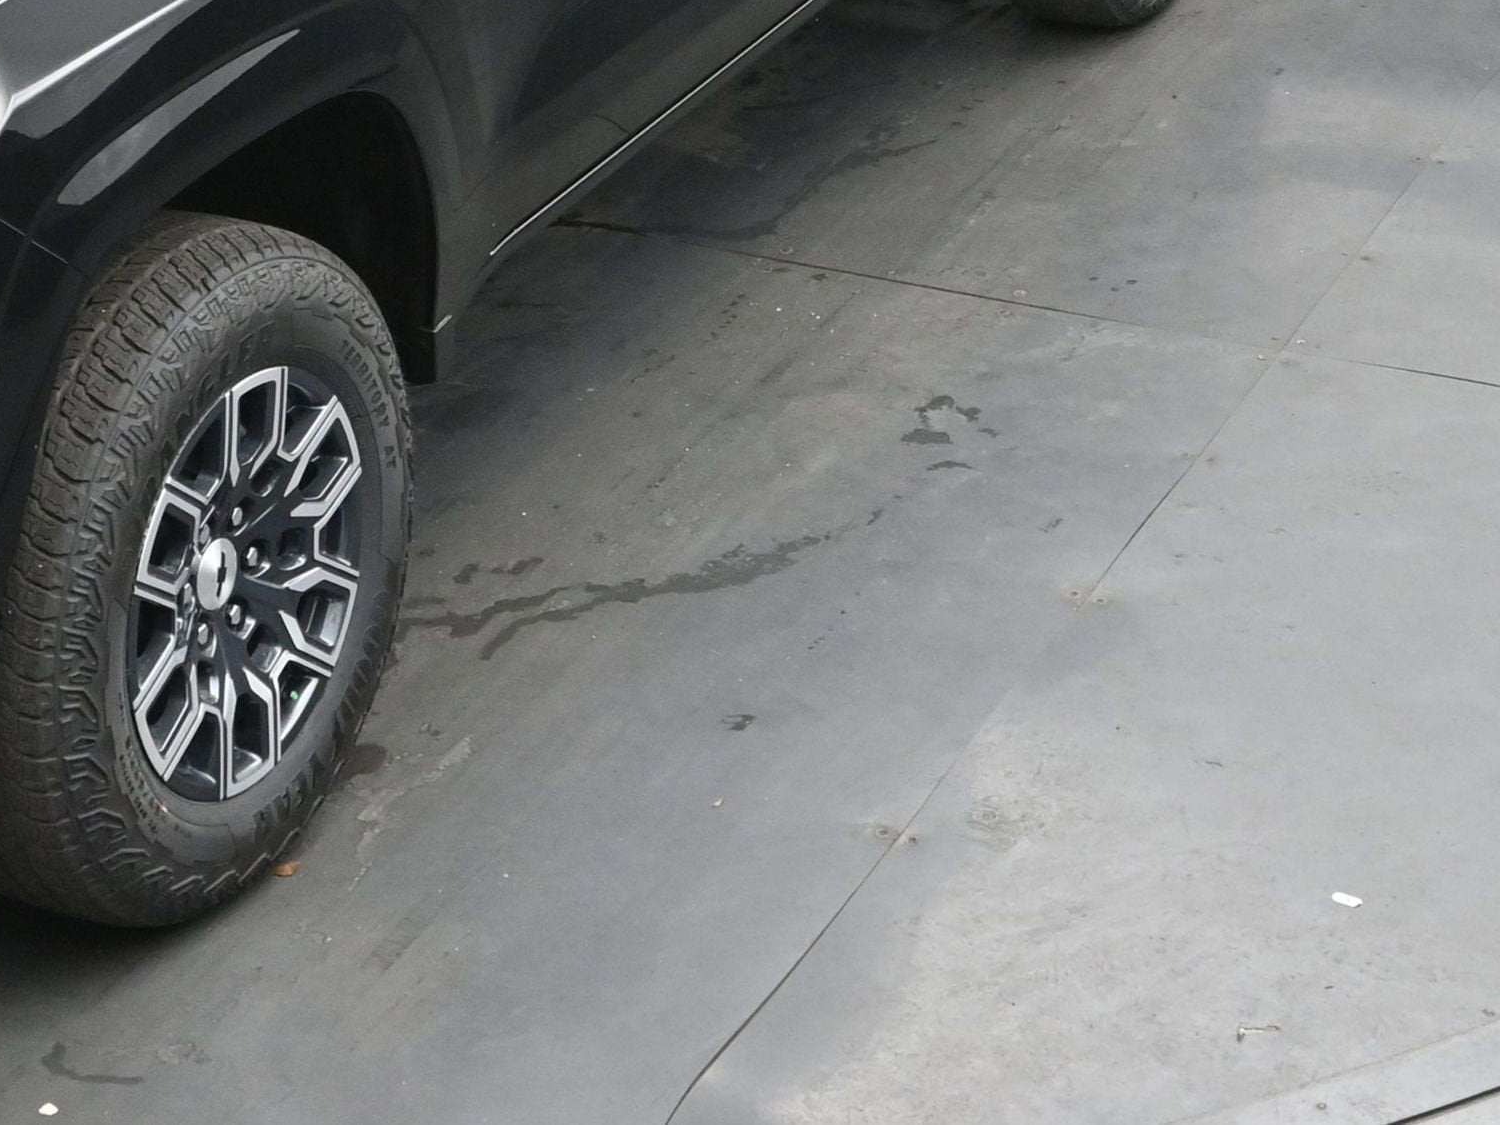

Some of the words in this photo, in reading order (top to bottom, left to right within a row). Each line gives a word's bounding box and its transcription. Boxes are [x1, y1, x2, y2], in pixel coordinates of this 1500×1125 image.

[124, 321, 276, 555] RANGLER
[341, 339, 390, 427] TERRITORY
[383, 445, 397, 468] AT
